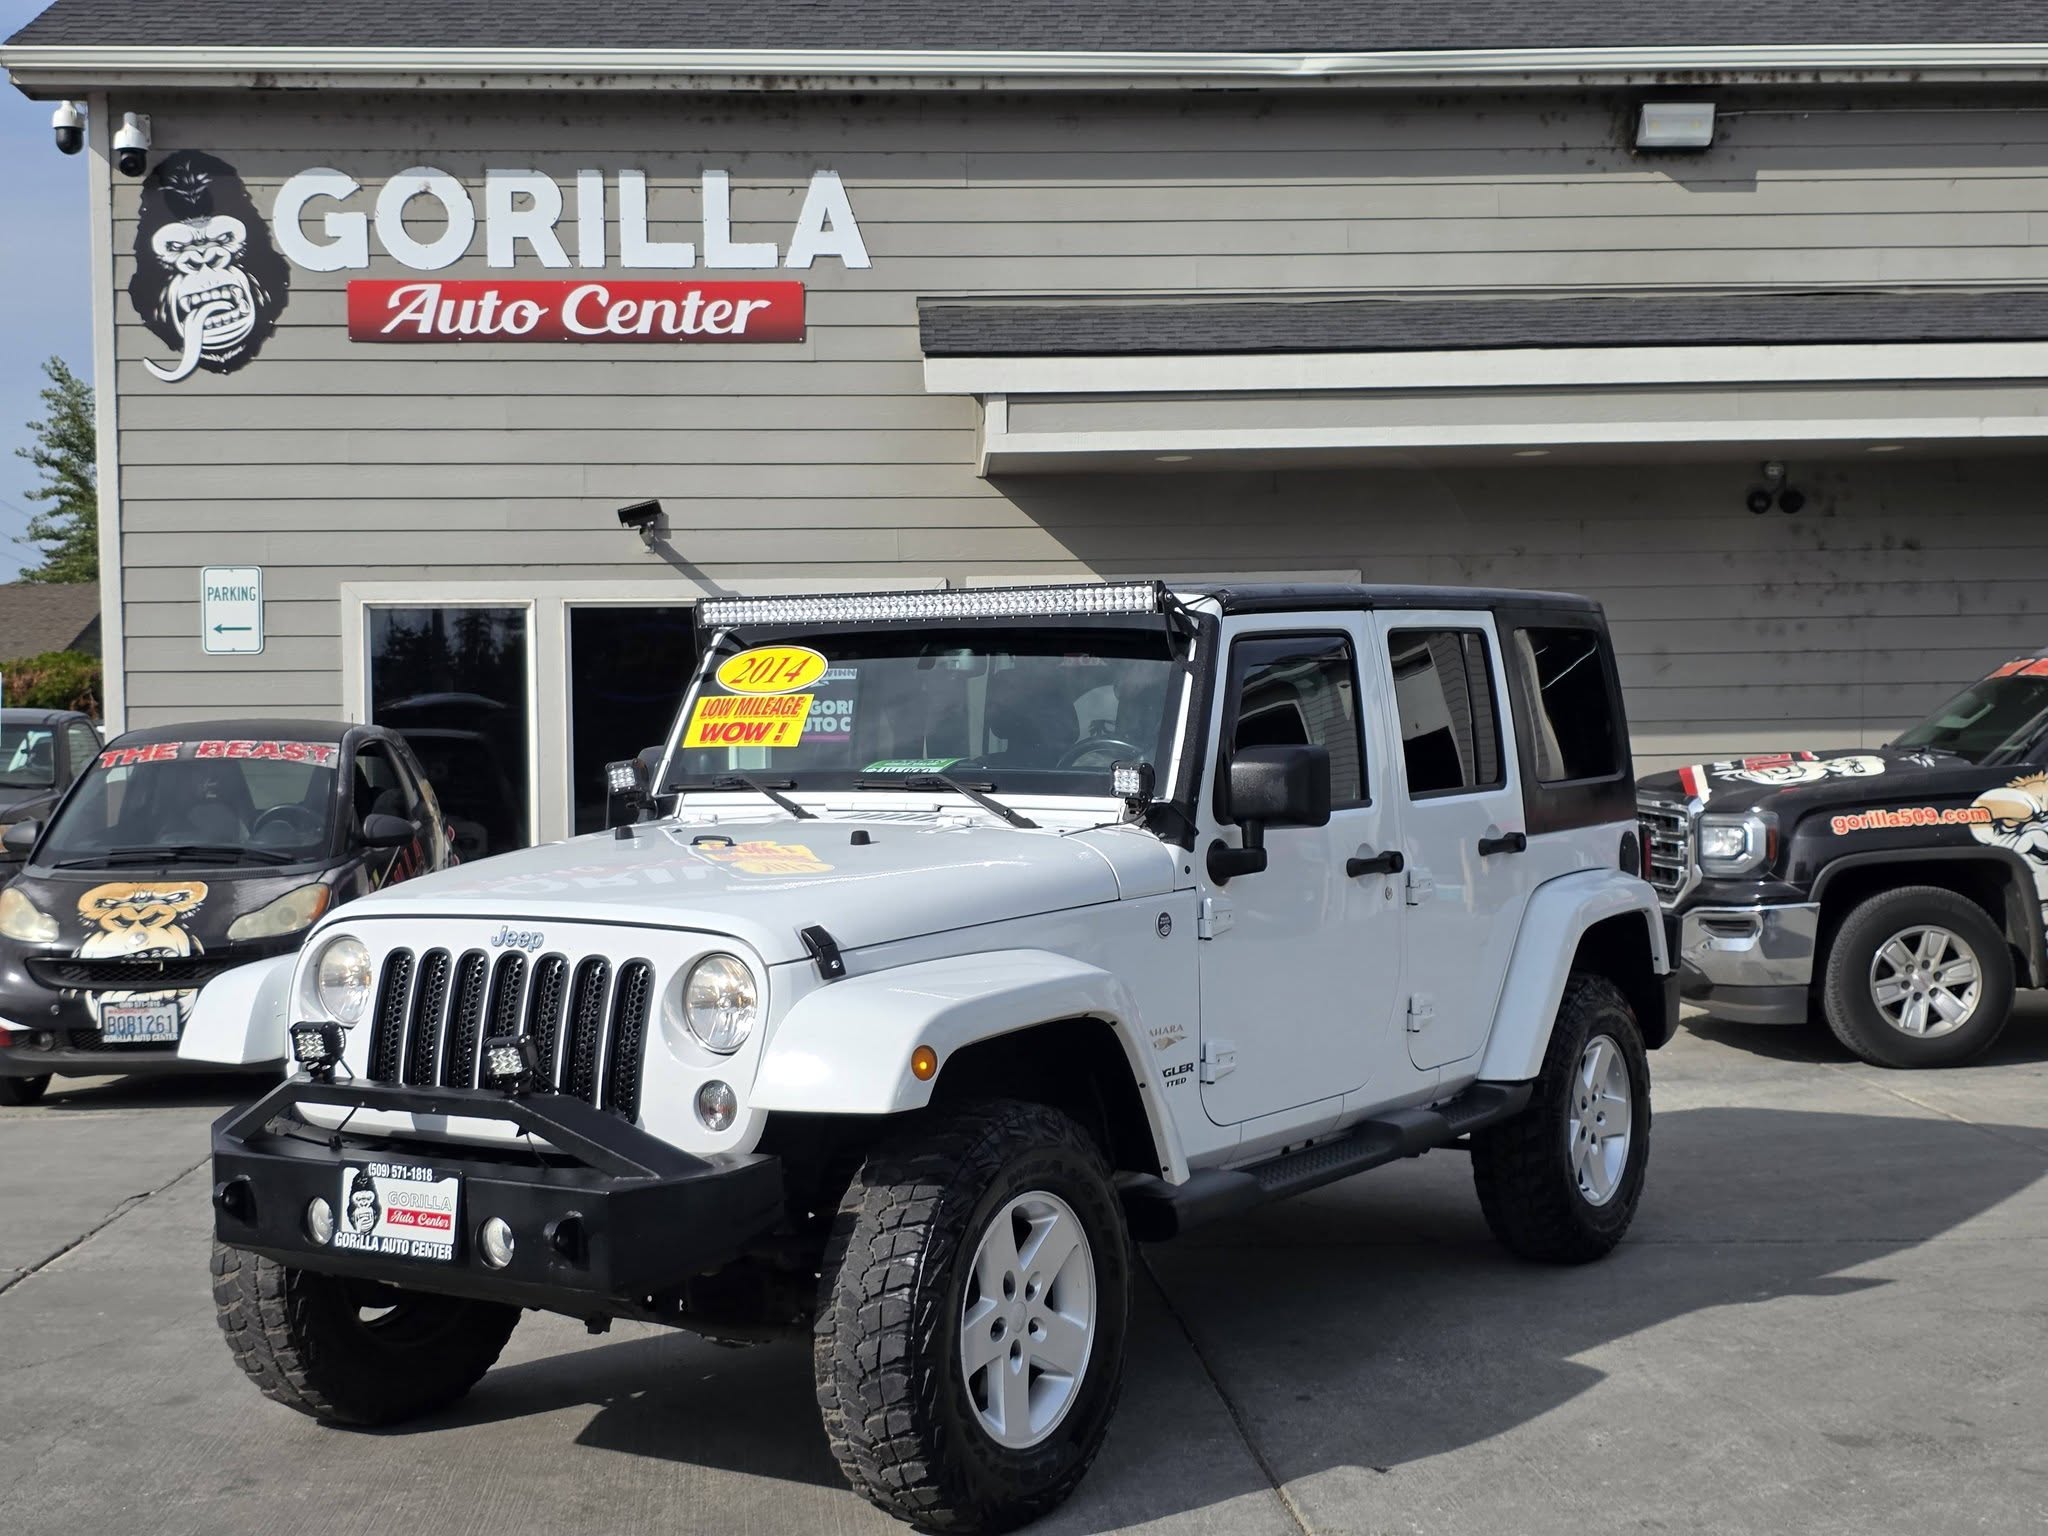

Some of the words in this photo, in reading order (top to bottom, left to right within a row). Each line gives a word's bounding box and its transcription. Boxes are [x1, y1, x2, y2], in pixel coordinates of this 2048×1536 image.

[272, 166, 872, 271] GORILLA
[380, 283, 549, 334] Auto
[562, 284, 772, 335] Center
[207, 586, 257, 602] PARKING
[729, 655, 813, 684] 2014
[700, 697, 736, 720] LOW
[733, 696, 806, 719] MILEAGE
[699, 721, 774, 744] WOW
[99, 742, 184, 769] THE
[195, 740, 337, 764] BEAST
[1831, 807, 1992, 835] gorilla509.com
[491, 925, 545, 953] Jeep
[368, 1162, 390, 1178] (509)
[391, 1165, 433, 1181] 571-1818
[387, 1191, 452, 1211] GORILLA
[391, 1209, 415, 1224] Auto
[418, 1213, 449, 1228] Center
[380, 1237, 410, 1256] AUTO
[410, 1242, 453, 1260] CENTER
